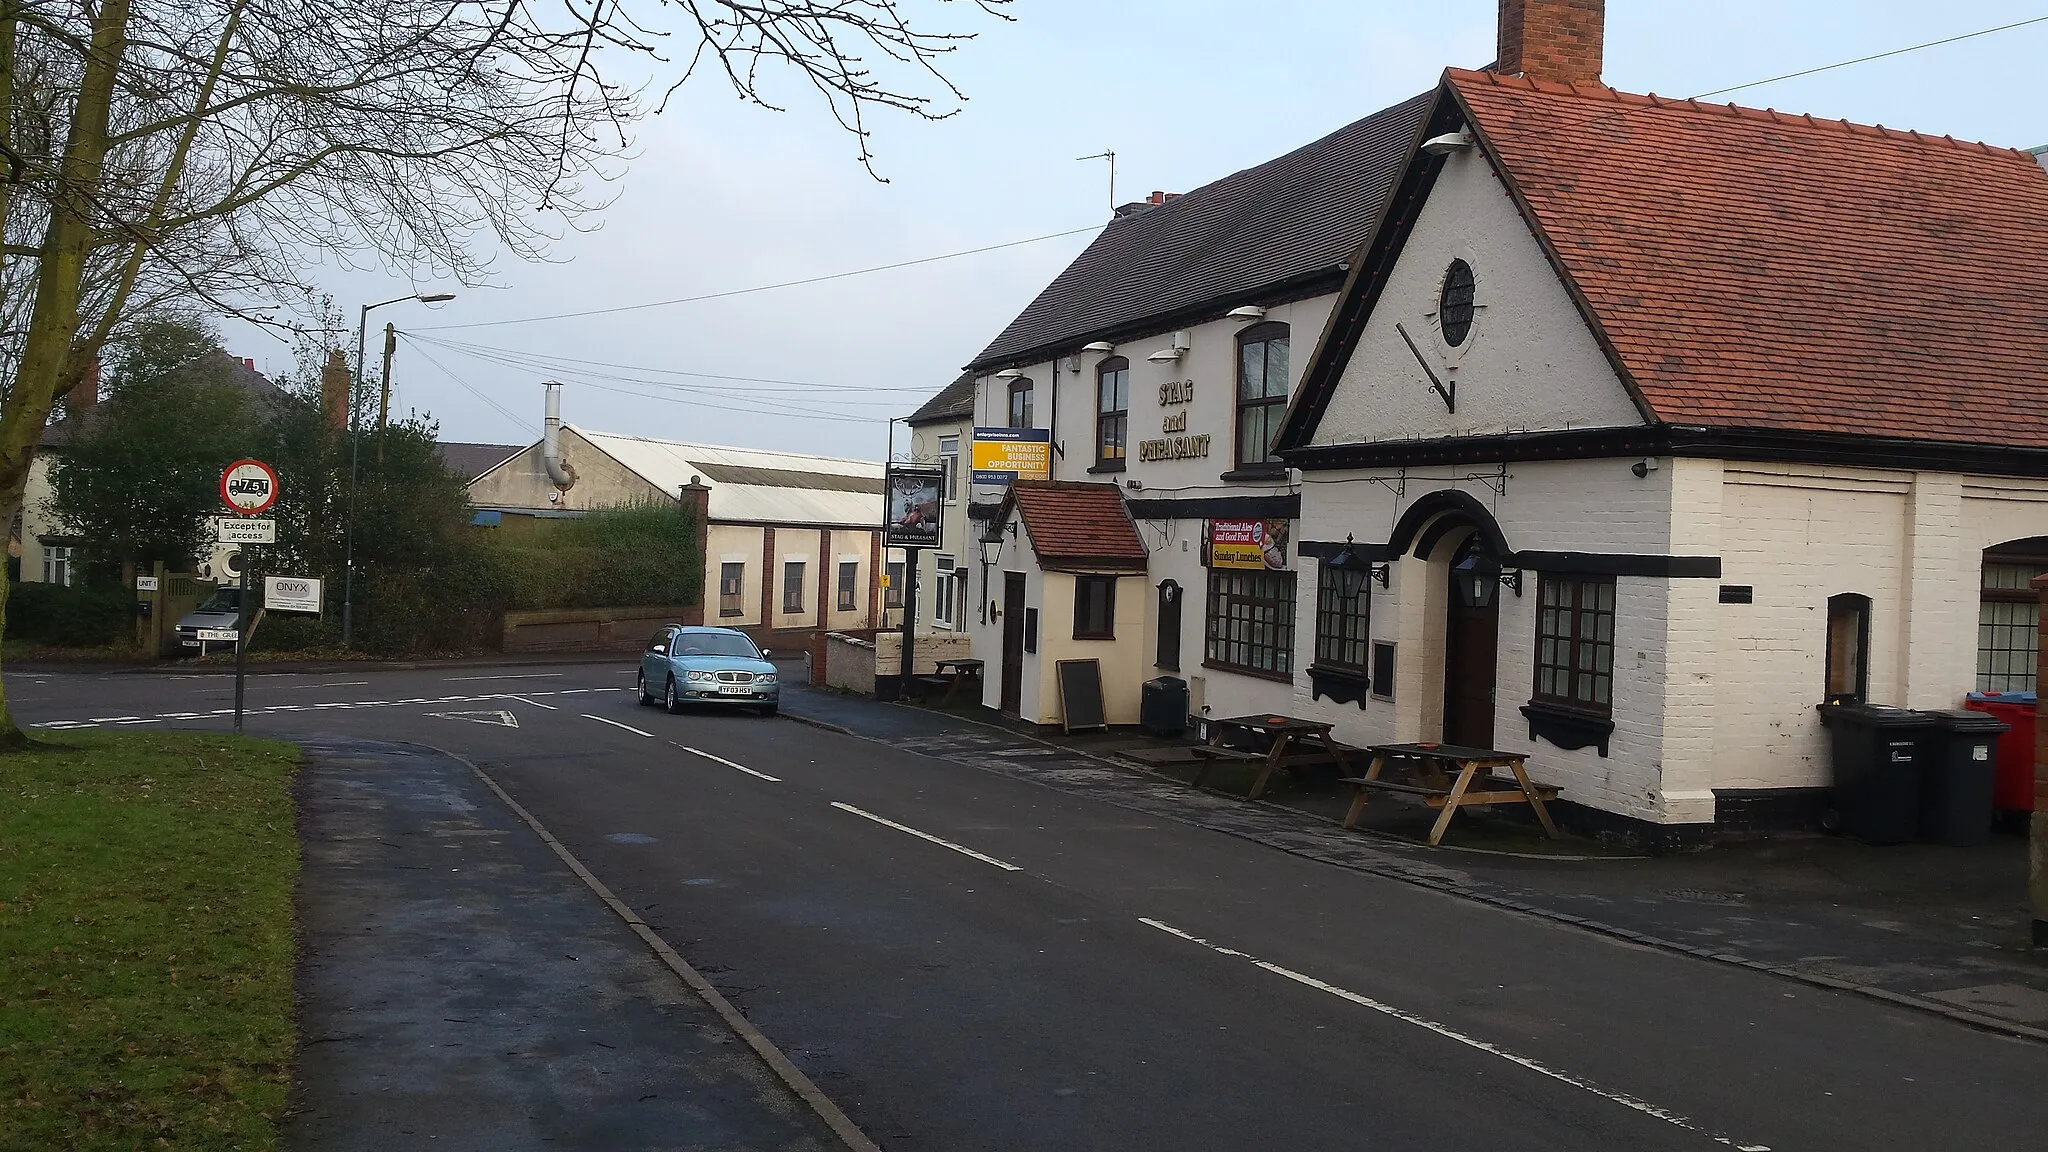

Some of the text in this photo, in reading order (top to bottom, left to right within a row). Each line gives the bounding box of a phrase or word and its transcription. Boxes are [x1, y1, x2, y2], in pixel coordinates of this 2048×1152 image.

[1159, 379, 1193, 406] STAG
[1163, 409, 1186, 433] and
[1001, 444, 1046, 453] FANTASTIC
[1139, 434, 1210, 462] PHEASANT
[1007, 452, 1046, 461] BUSINESS
[987, 460, 1046, 469] OPPORTUNITY
[224, 521, 271, 531] Except for
[1215, 522, 1253, 532] Traditional Ales
[1215, 532, 1225, 541] and
[1225, 532, 1237, 541] Good
[1237, 532, 1250, 541] Food
[1214, 550, 1262, 564] Sunday Lunches
[276, 582, 307, 593] ONYX
